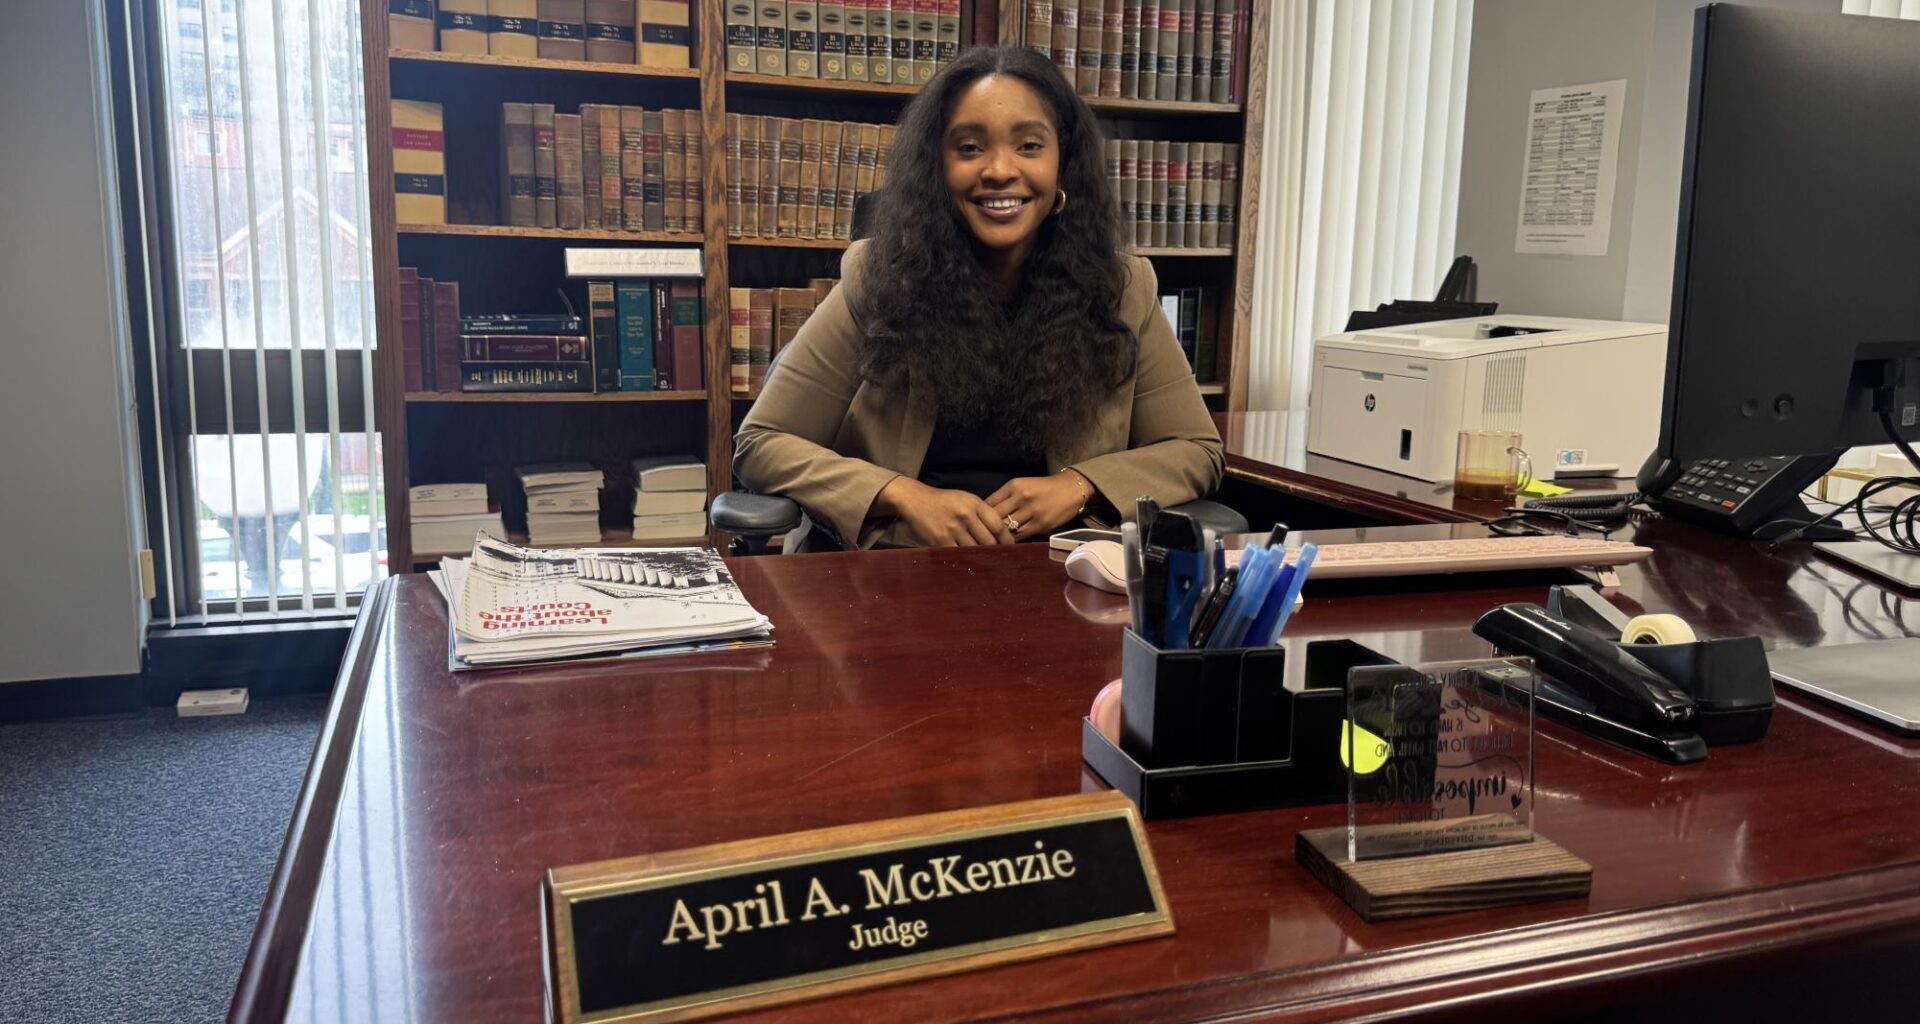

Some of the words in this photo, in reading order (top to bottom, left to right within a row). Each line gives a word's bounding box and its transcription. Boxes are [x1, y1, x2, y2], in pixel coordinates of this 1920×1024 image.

[501, 602, 592, 613] Courts
[479, 610, 523, 622] the
[534, 608, 613, 620] about
[482, 617, 609, 630] Learning
[663, 879, 789, 950] April
[801, 876, 850, 921] A.
[859, 840, 1077, 908] McKenzie
[849, 917, 929, 951] Judge
